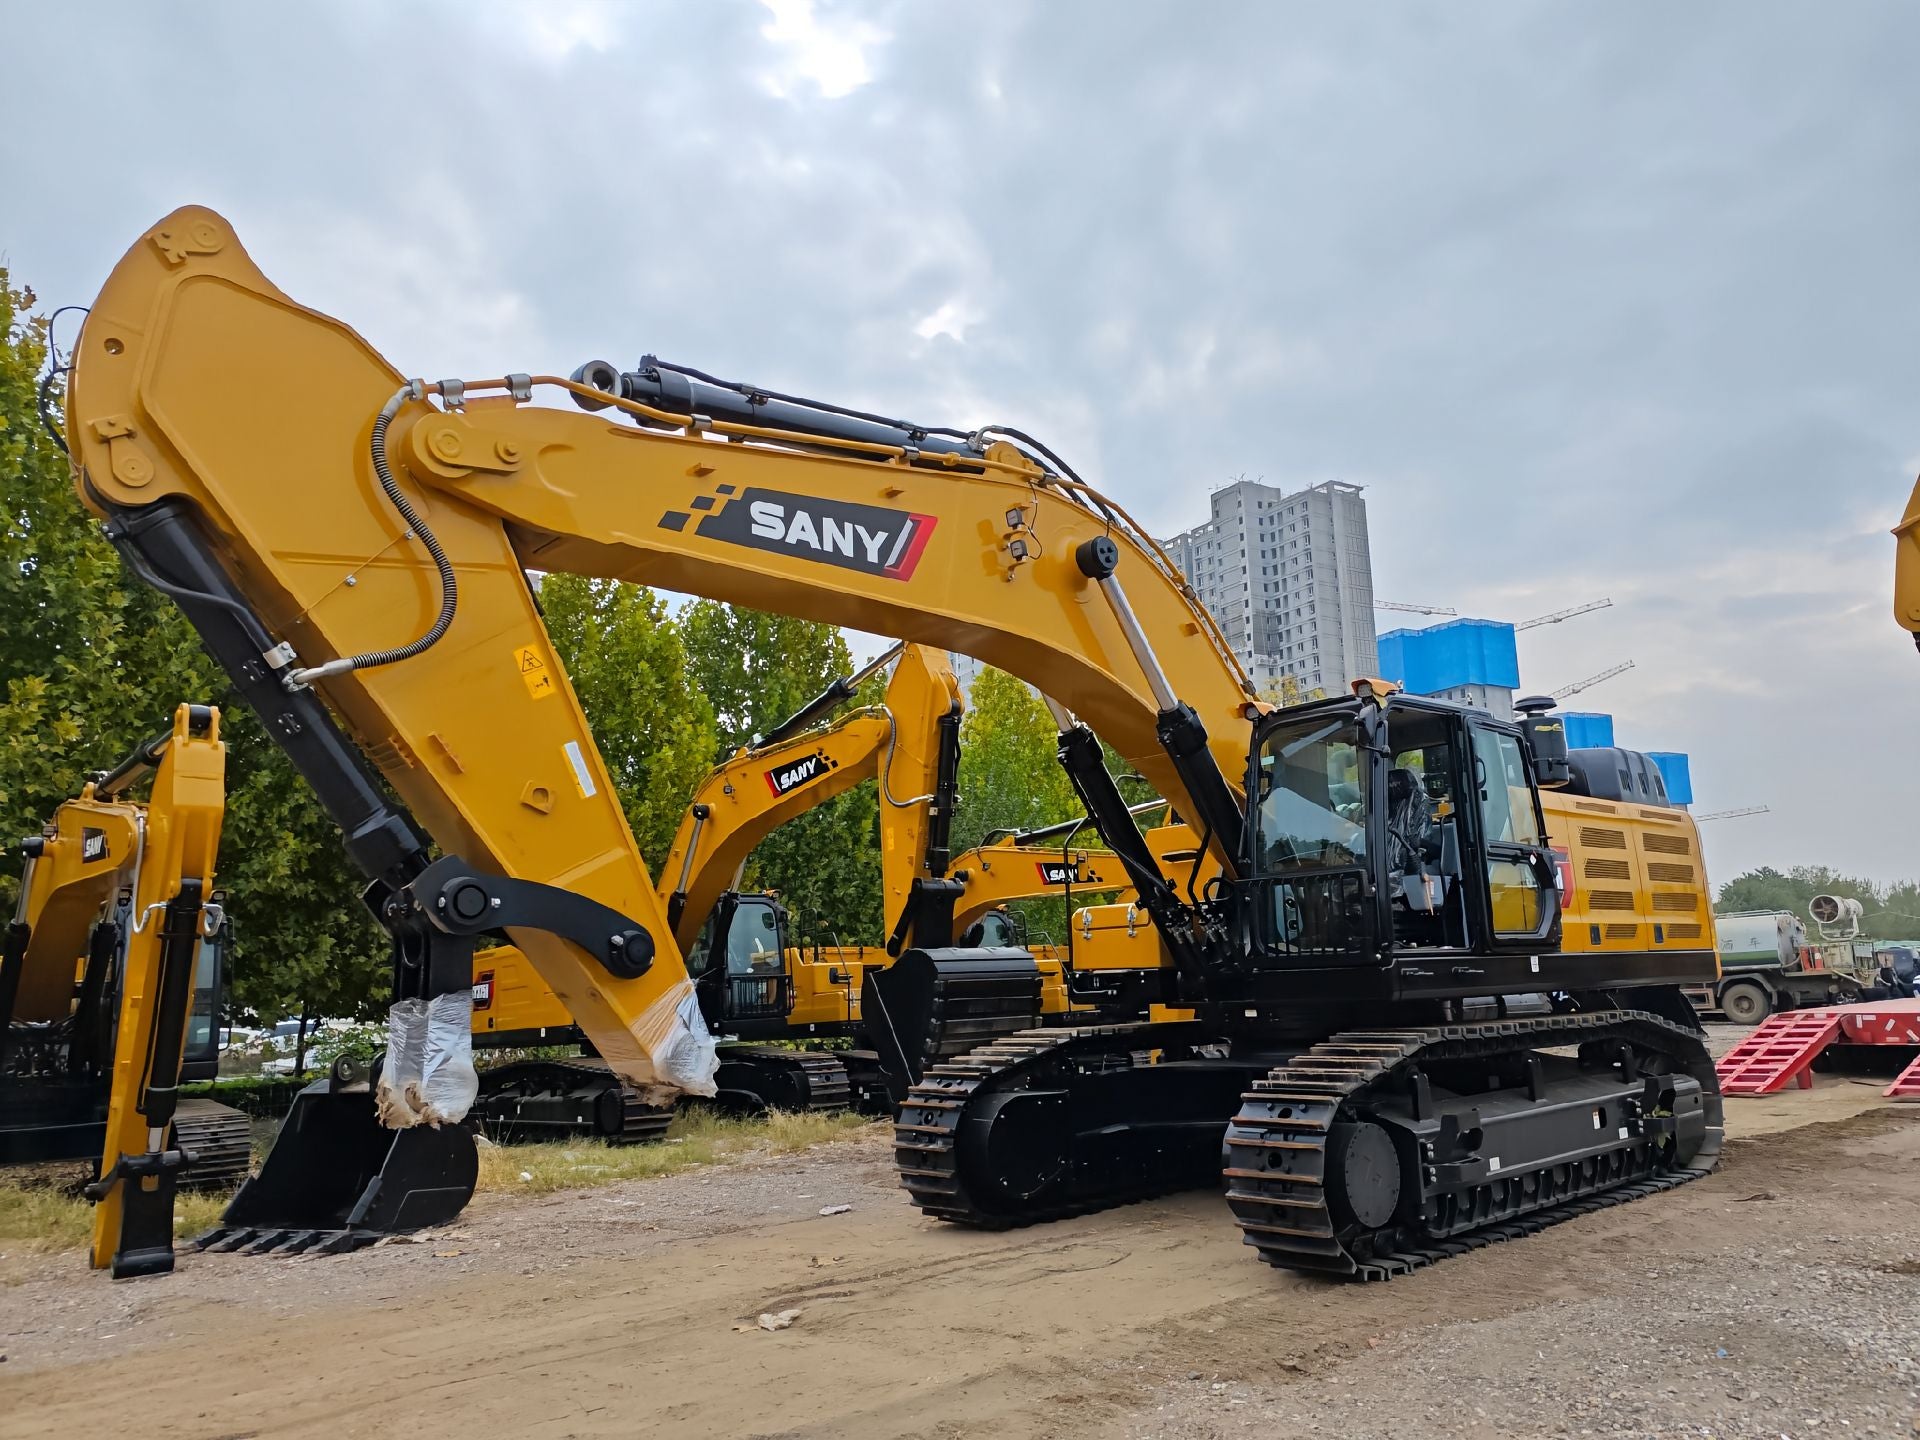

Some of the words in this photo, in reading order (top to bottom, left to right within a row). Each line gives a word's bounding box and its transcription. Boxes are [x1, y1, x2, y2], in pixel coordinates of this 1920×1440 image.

[750, 500, 892, 564] SANY
[780, 757, 817, 789] SANY
[1050, 868, 1078, 883] SAN
